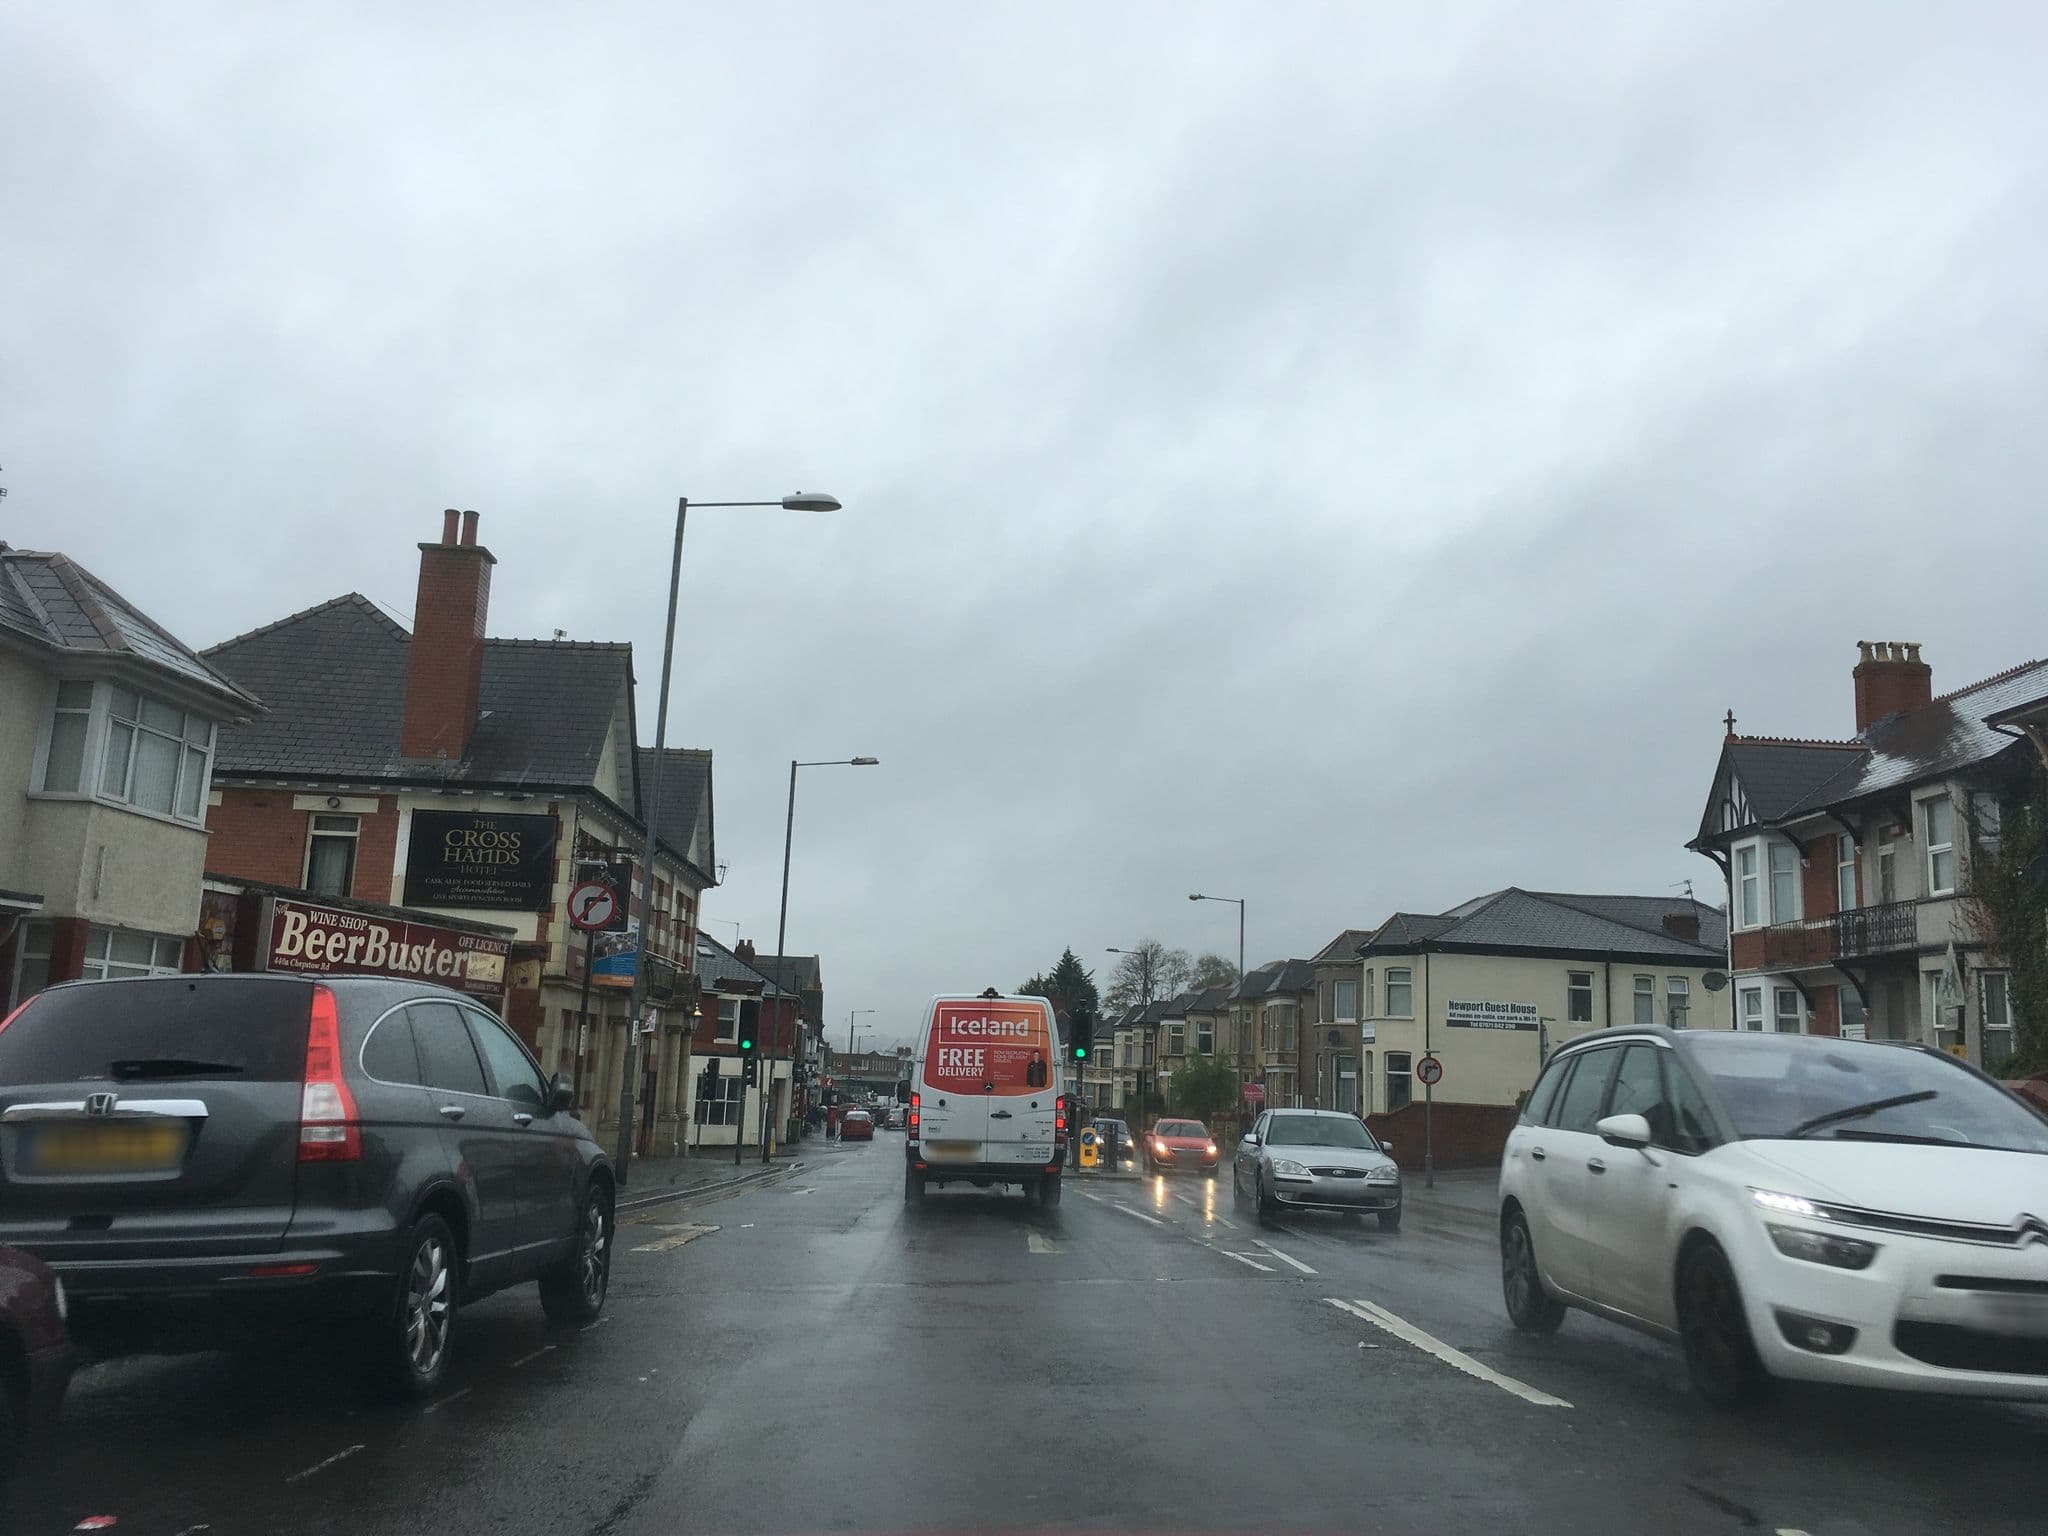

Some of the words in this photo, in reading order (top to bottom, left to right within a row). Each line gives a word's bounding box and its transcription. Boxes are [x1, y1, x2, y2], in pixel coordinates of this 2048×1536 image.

[473, 820, 496, 830] THE
[446, 830, 520, 848] CROSS
[443, 848, 520, 864] HANDS
[310, 910, 338, 927] WINE
[339, 916, 368, 930] SHOP
[458, 936, 474, 948] OFF
[475, 938, 509, 954] LICENCE
[290, 958, 320, 970] Chepstow
[320, 962, 330, 971] Rd
[1448, 1000, 1484, 1012] Newport
[1485, 1002, 1509, 1013] Guest
[1510, 1003, 1536, 1014] House
[952, 1016, 1029, 1036] Iceland
[938, 1048, 984, 1066] FREE
[938, 1066, 984, 1076] DELIVERY
